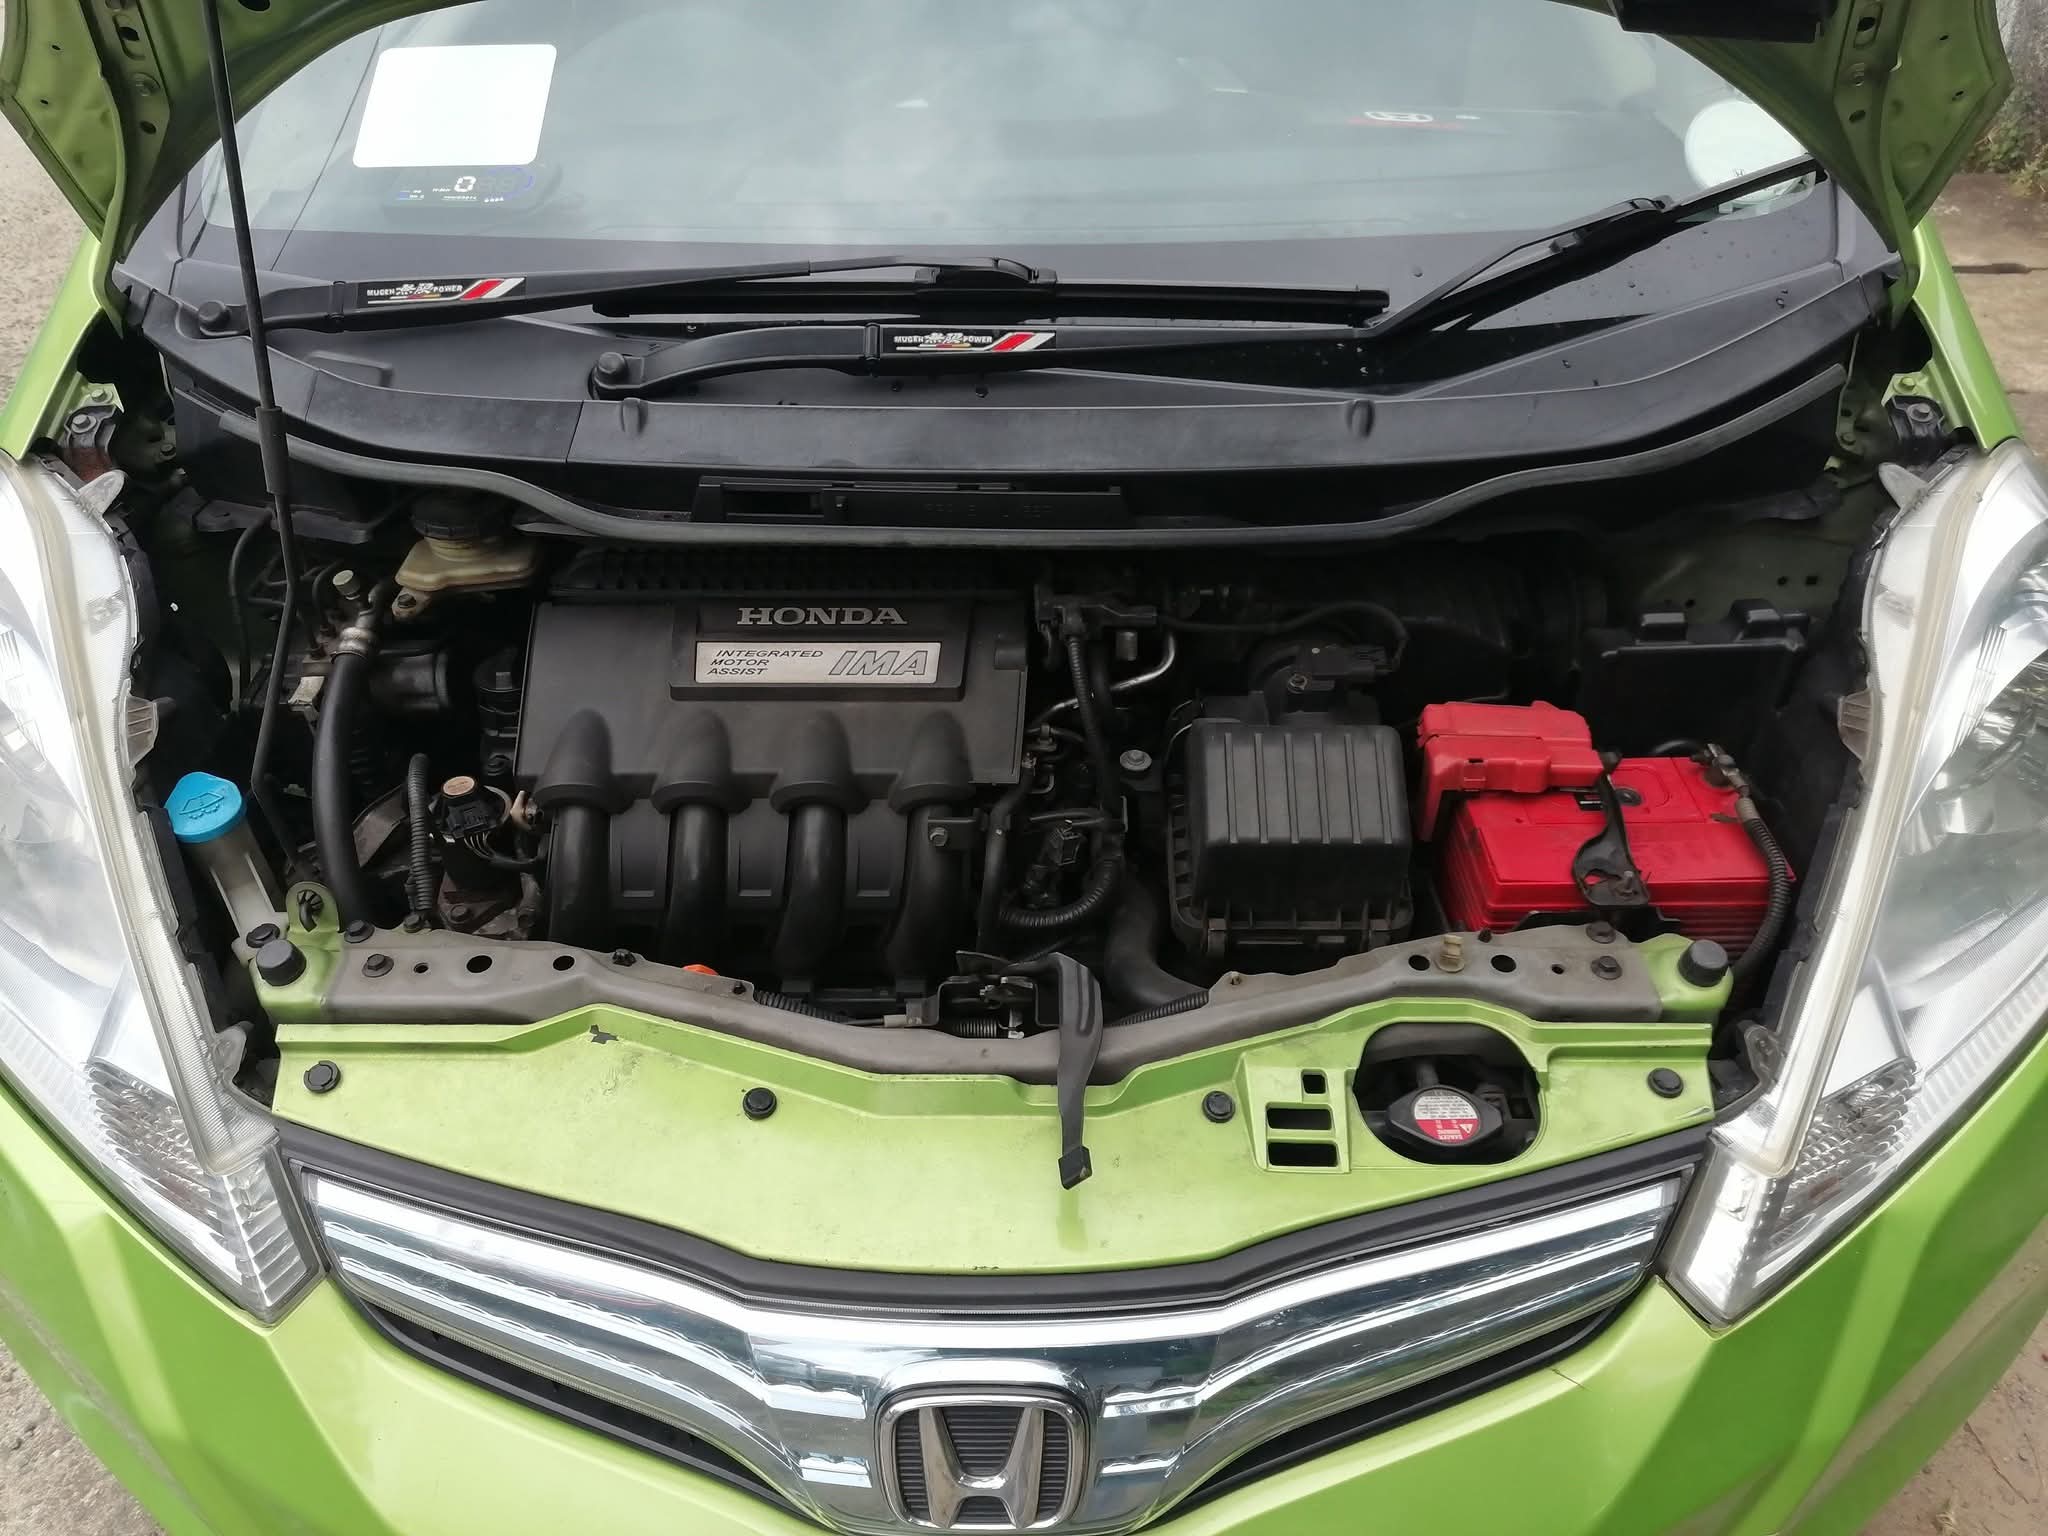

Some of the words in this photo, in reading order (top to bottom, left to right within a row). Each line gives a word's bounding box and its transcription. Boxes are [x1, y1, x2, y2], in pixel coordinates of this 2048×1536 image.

[433, 285, 463, 293] POWER
[894, 335, 924, 343] MUGEN
[963, 335, 992, 343] POWER
[736, 607, 908, 625] HONDA
[715, 649, 823, 658] INTEGRATED
[710, 658, 770, 667] MOTOR
[828, 650, 929, 676] IMA
[707, 667, 768, 676] ASSIST
